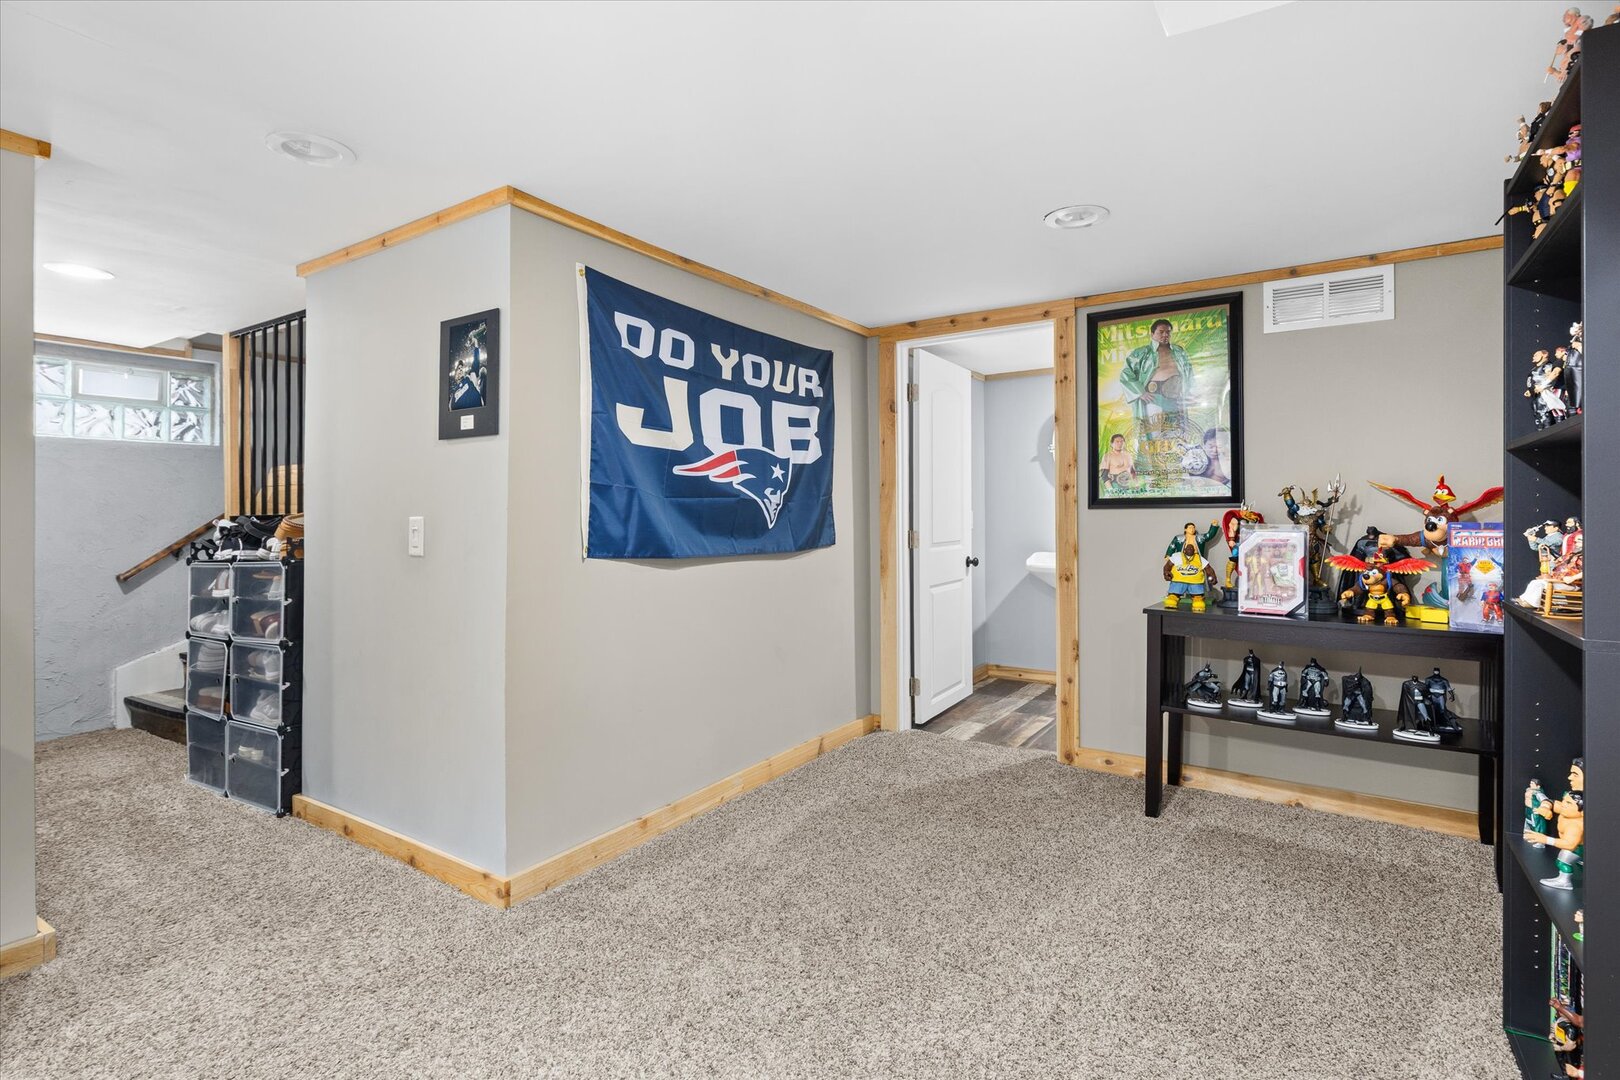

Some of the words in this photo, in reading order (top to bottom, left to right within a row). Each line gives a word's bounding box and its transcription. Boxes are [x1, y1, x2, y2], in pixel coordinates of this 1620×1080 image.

[614, 310, 695, 370] DO
[710, 343, 823, 398] YOUR
[616, 375, 823, 465] JOB
